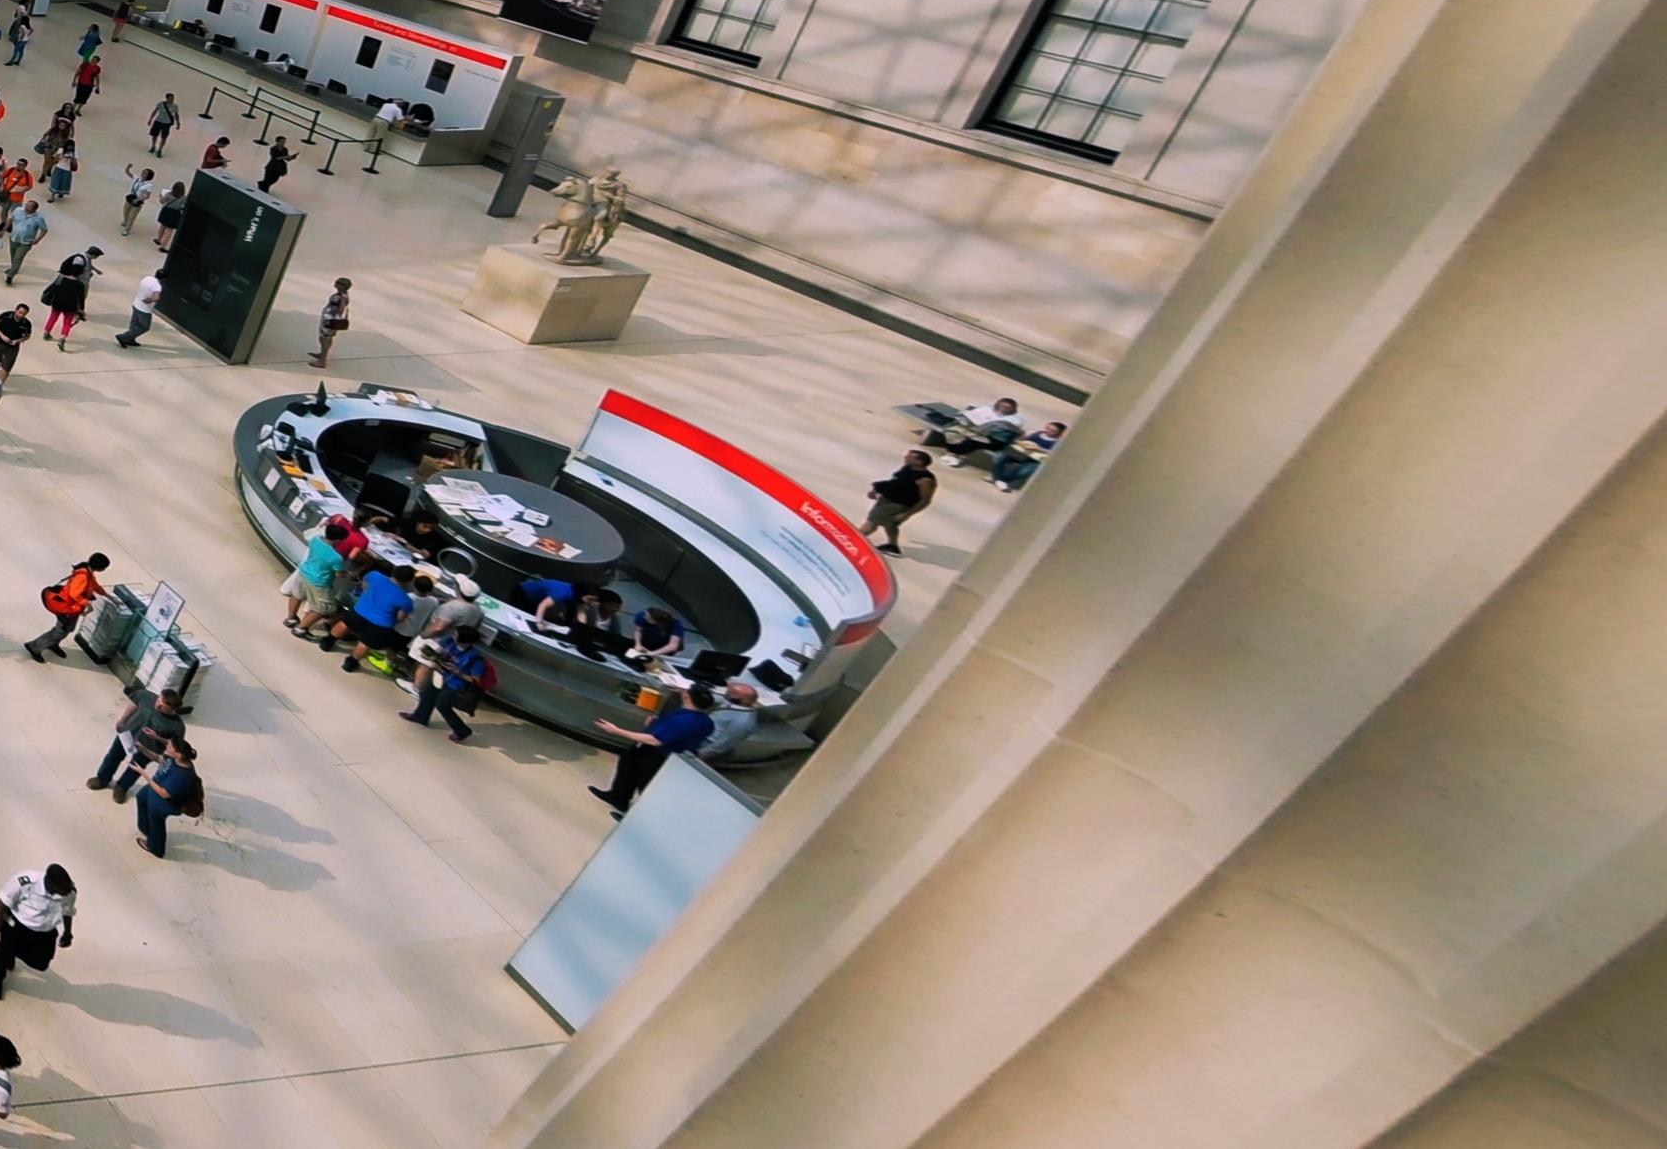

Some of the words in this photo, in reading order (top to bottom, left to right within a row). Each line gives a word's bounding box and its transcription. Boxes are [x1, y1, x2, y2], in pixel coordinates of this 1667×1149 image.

[243, 216, 260, 242] What's
[255, 206, 264, 217] on
[799, 501, 860, 557] Information
